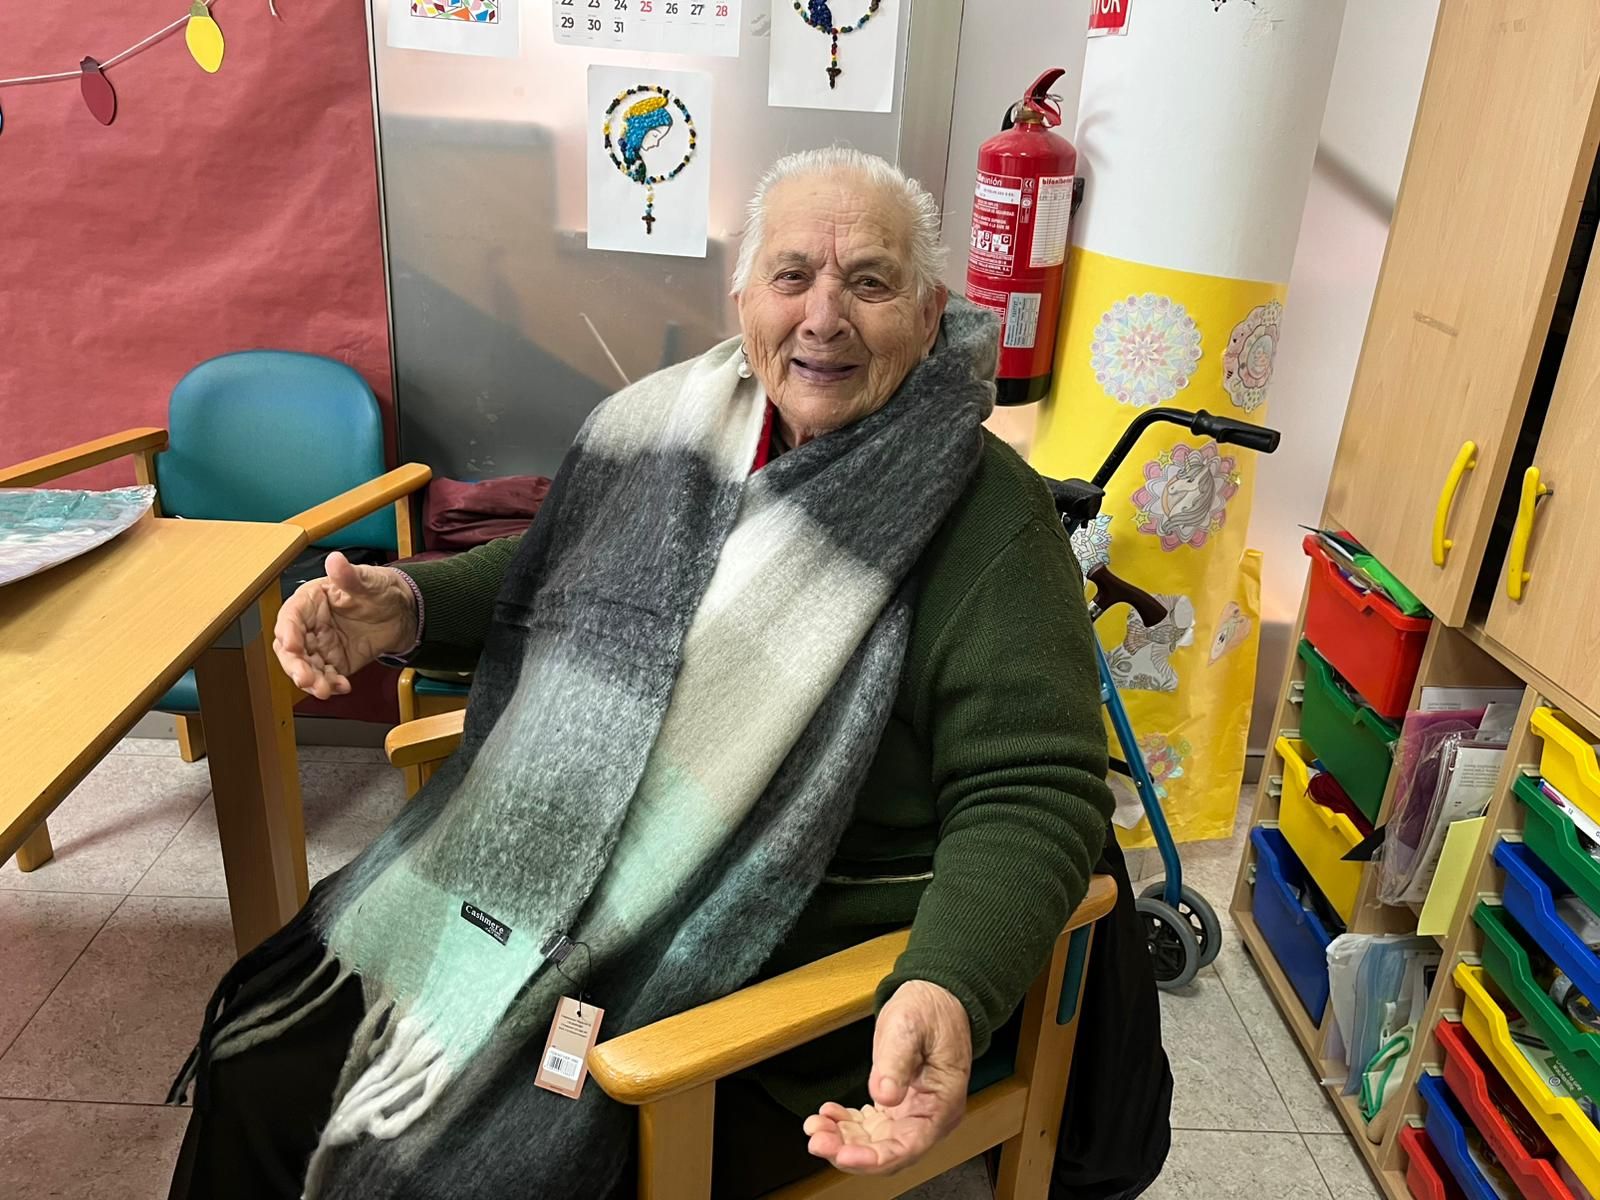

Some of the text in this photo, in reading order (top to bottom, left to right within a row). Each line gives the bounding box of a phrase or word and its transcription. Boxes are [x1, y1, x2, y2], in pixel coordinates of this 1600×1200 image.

[588, 0, 600, 8] 23
[614, 0, 628, 11] 24
[640, 1, 653, 13] 25
[666, 3, 678, 15] 26
[691, 4, 704, 16] 27
[716, 5, 728, 17] 28
[561, 17, 624, 33] 29 30 31
[465, 905, 504, 934] Cashmere
